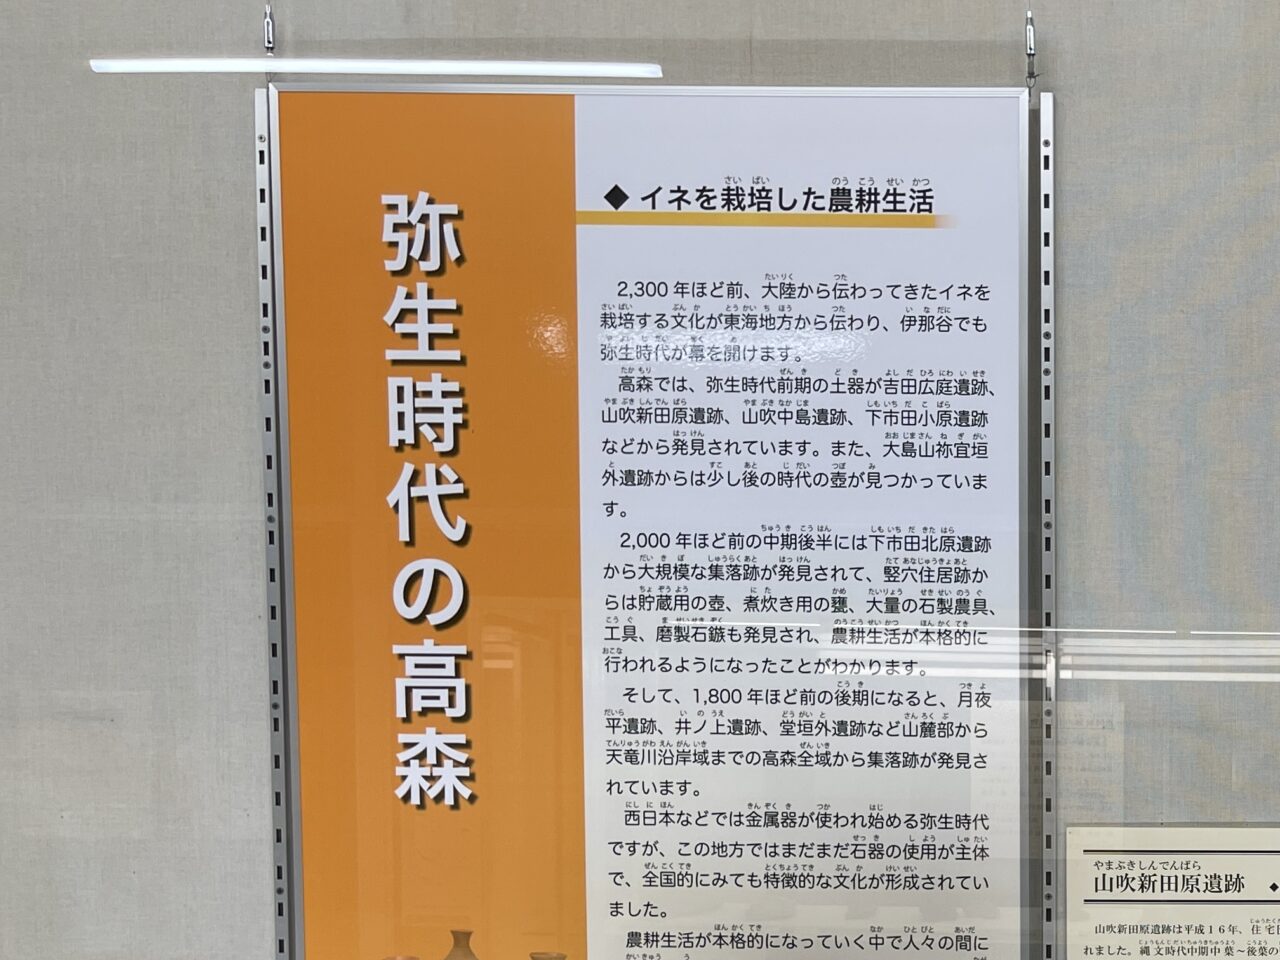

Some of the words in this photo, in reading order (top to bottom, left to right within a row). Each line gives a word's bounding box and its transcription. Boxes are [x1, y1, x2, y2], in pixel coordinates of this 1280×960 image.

[640, 185, 935, 214] イネを栽培した農耕生活
[380, 191, 472, 808] 弥生時代の高森
[602, 500, 628, 518] す。
[604, 657, 928, 676] 行われるようになったことがわかります。
[606, 779, 703, 797] れています。
[625, 810, 990, 831] 西日本などでは金属器が使われ始める弥生時代
[608, 840, 990, 861] ですが、この地方ではまだまだ石器の使用が主体
[1093, 860, 1201, 871] やまぶきしんでんばら
[1093, 873, 1245, 894] 山吹新田原遺跡
[609, 900, 668, 918] ました。
[625, 930, 989, 951] 農耕生活が本格的になっていく中で人々の間に
